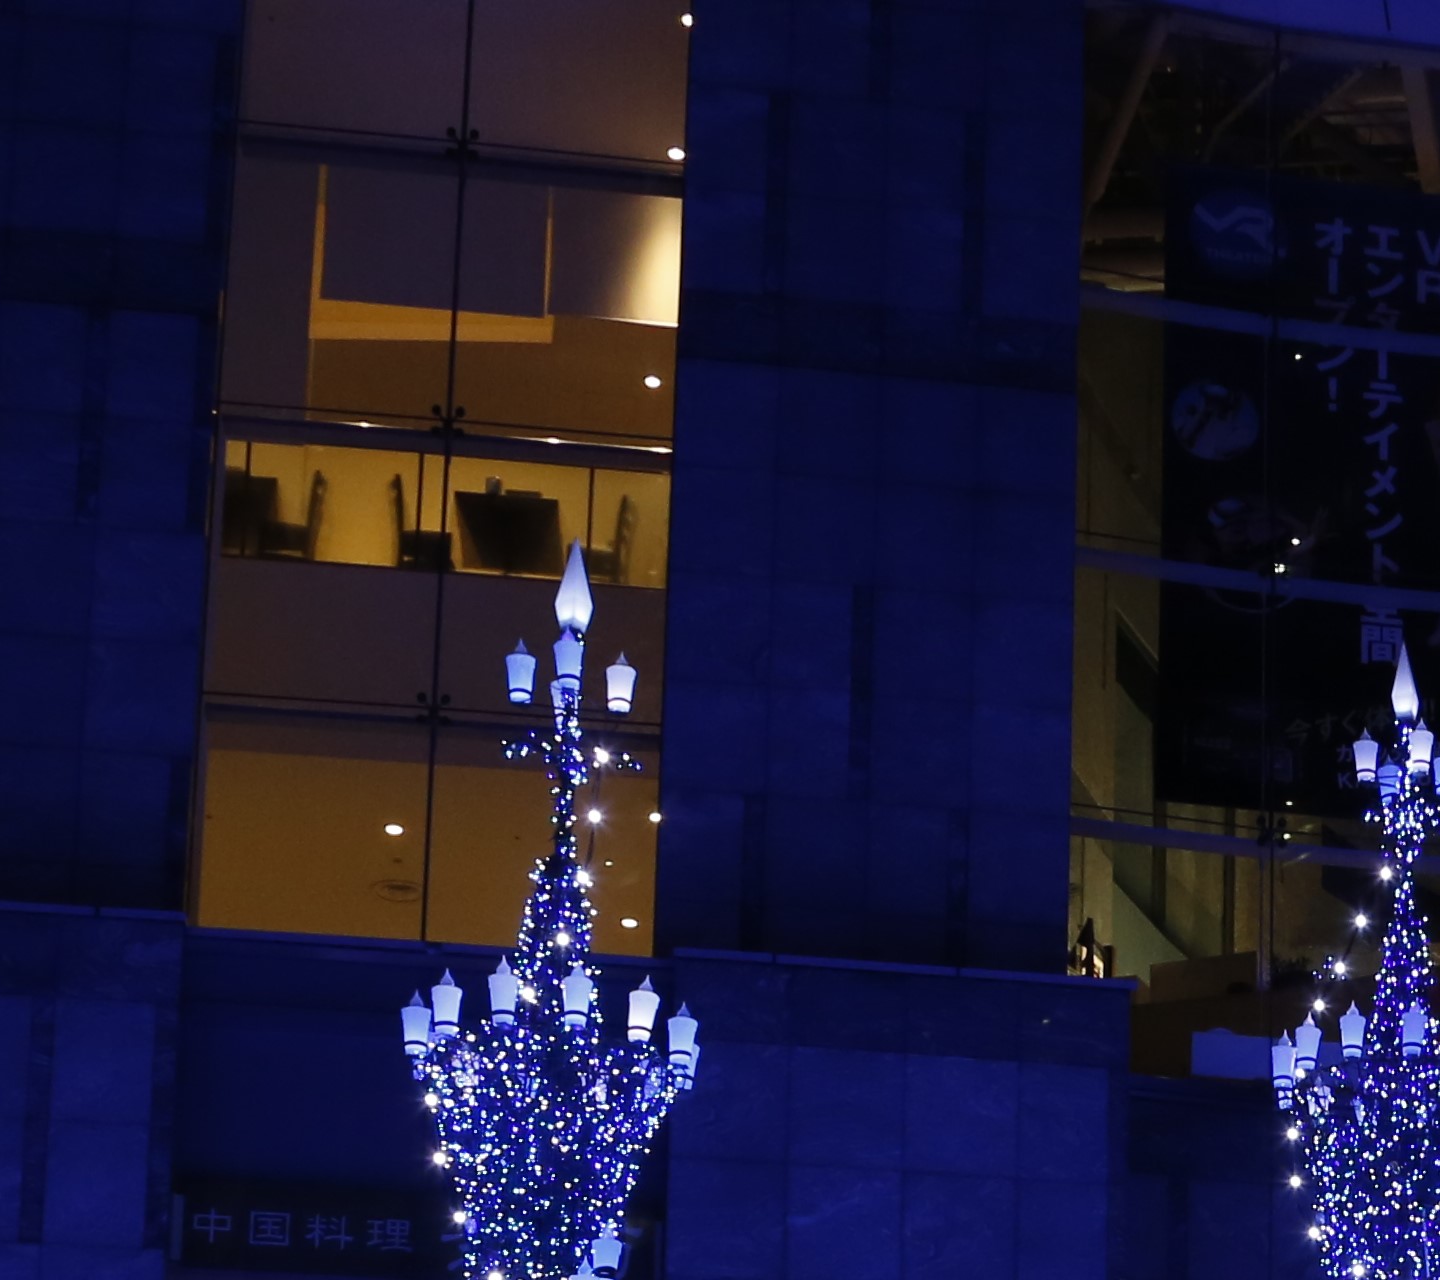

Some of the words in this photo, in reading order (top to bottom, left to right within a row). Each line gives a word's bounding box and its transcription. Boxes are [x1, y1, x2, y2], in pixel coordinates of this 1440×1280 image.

[1360, 223, 1405, 668] エンターテイメント間
[191, 1206, 414, 1253] 中国料理
